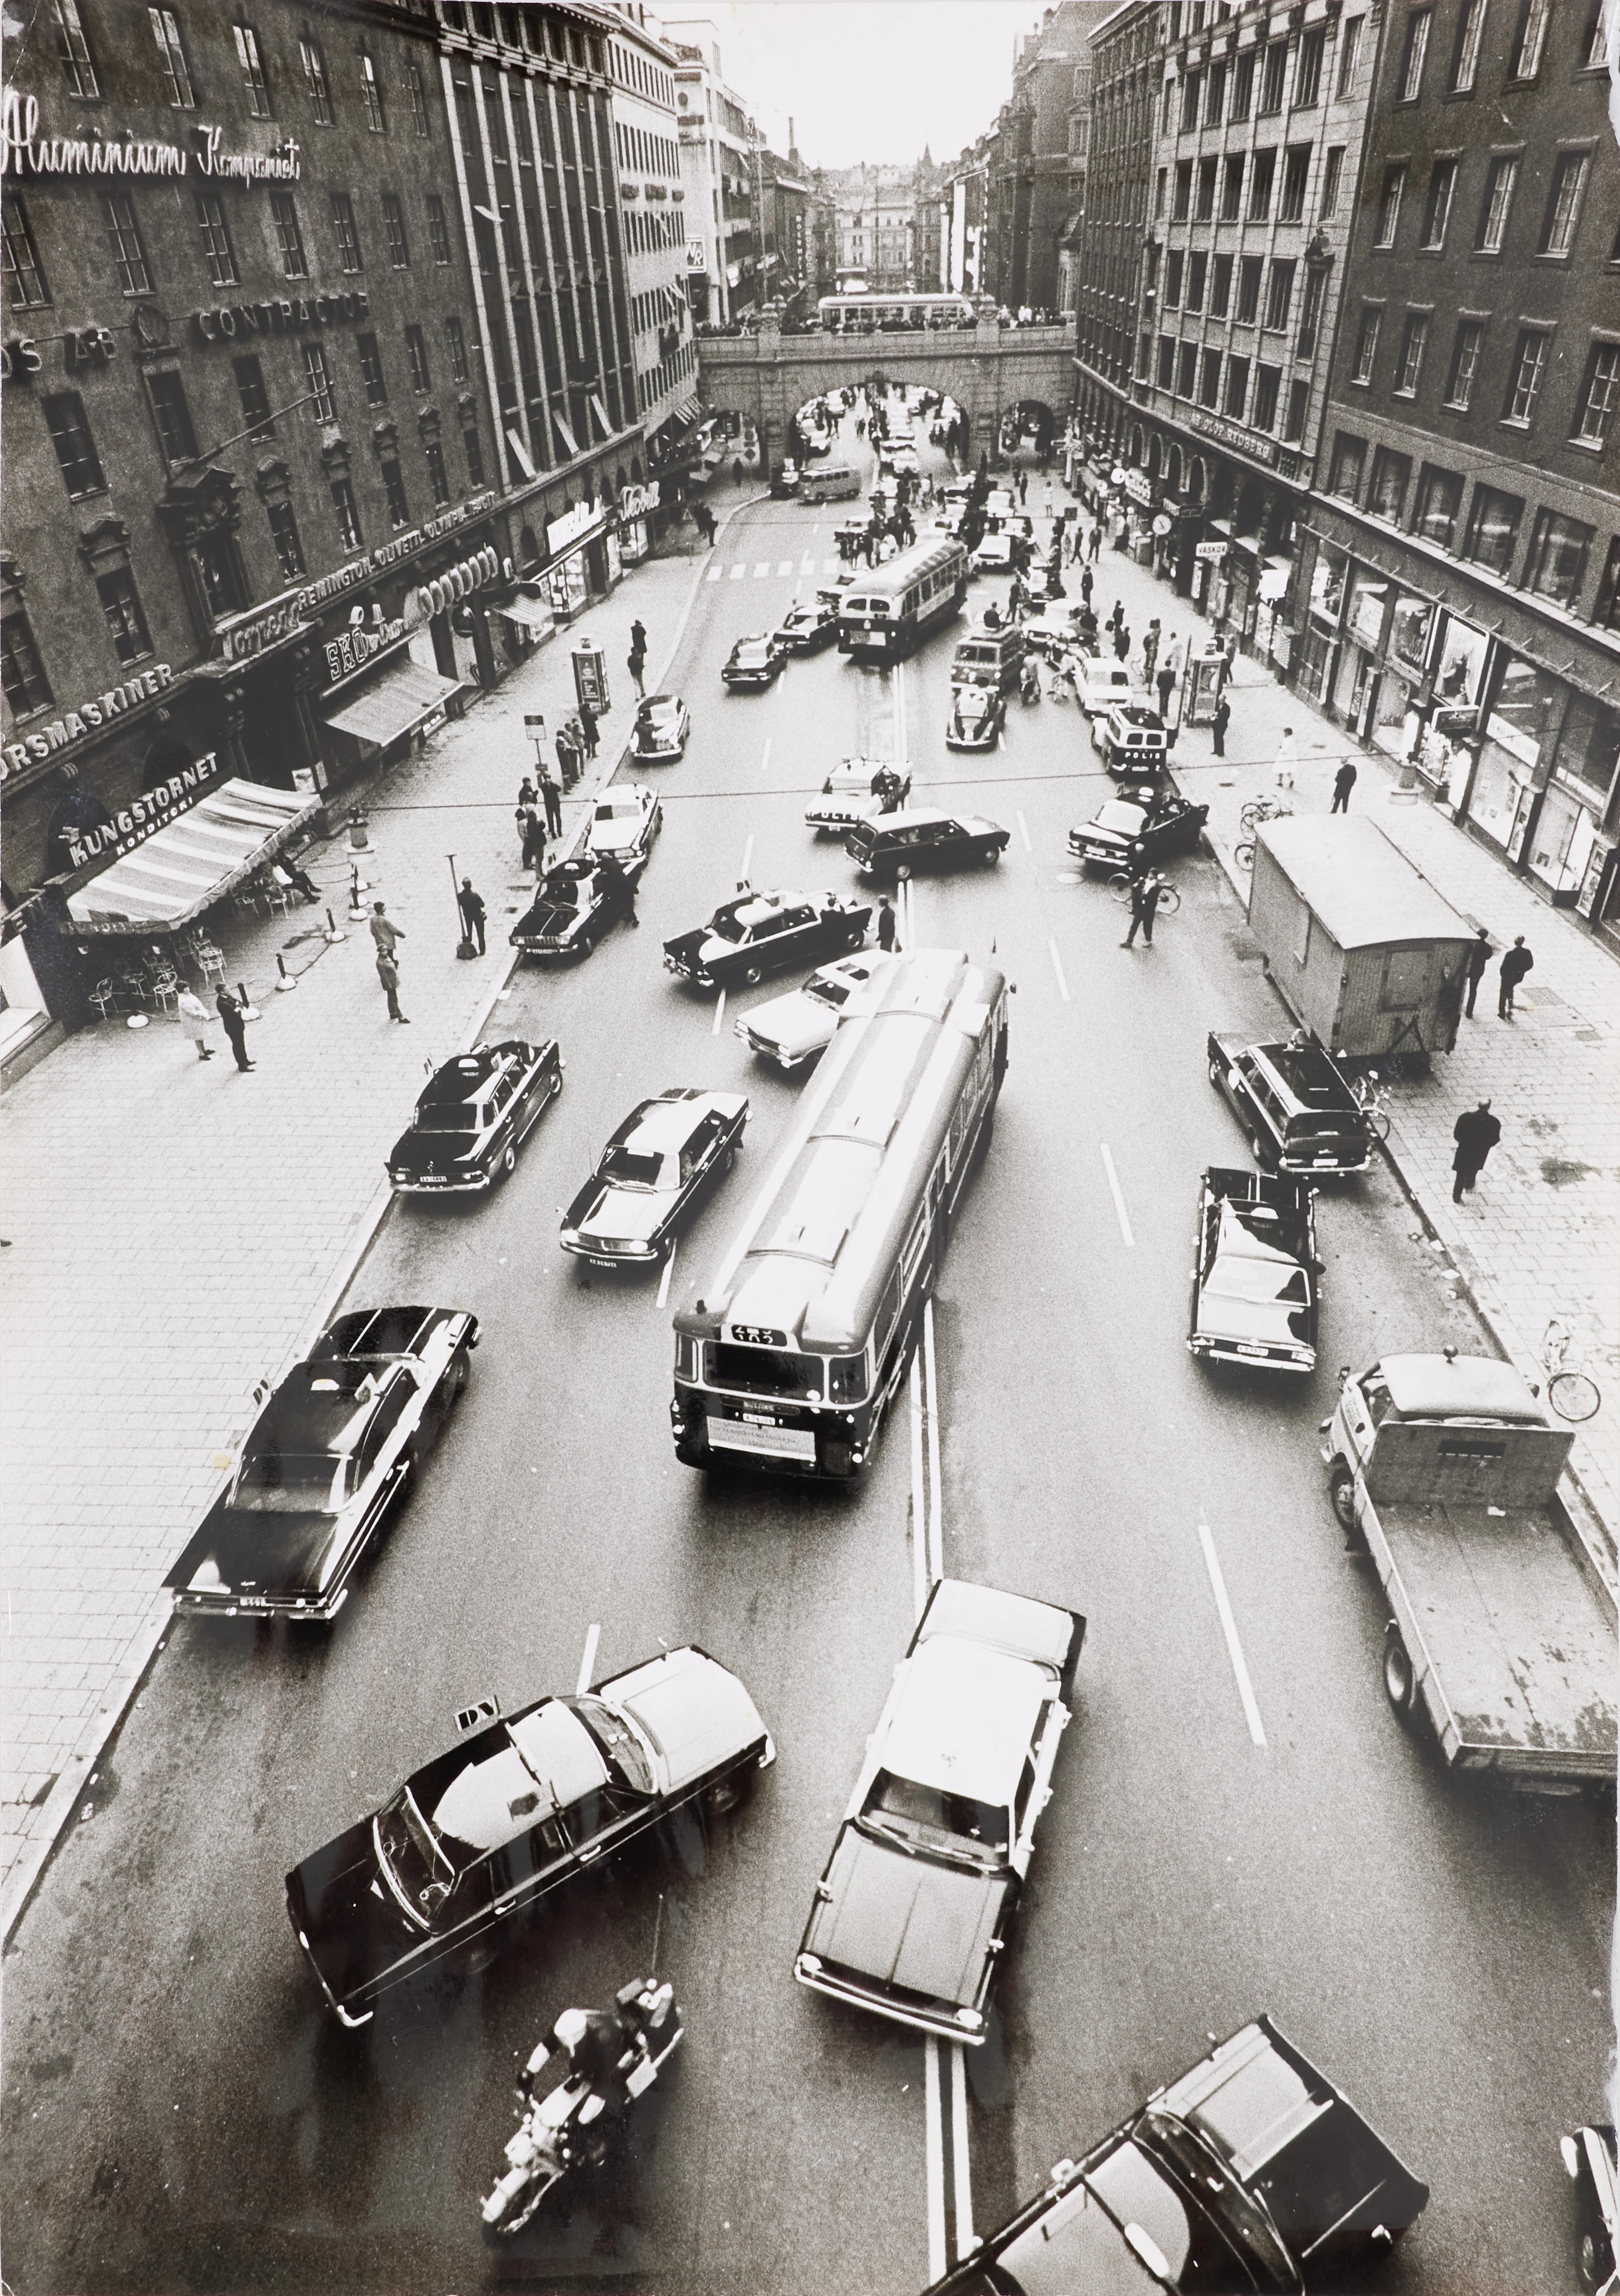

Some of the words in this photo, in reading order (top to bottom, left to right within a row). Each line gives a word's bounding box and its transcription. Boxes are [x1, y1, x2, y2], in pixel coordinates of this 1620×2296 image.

[200, 292, 368, 340] CONTRACTOR
[69, 751, 217, 867] KUNGSTORNET
[116, 796, 193, 856] KONDITORI
